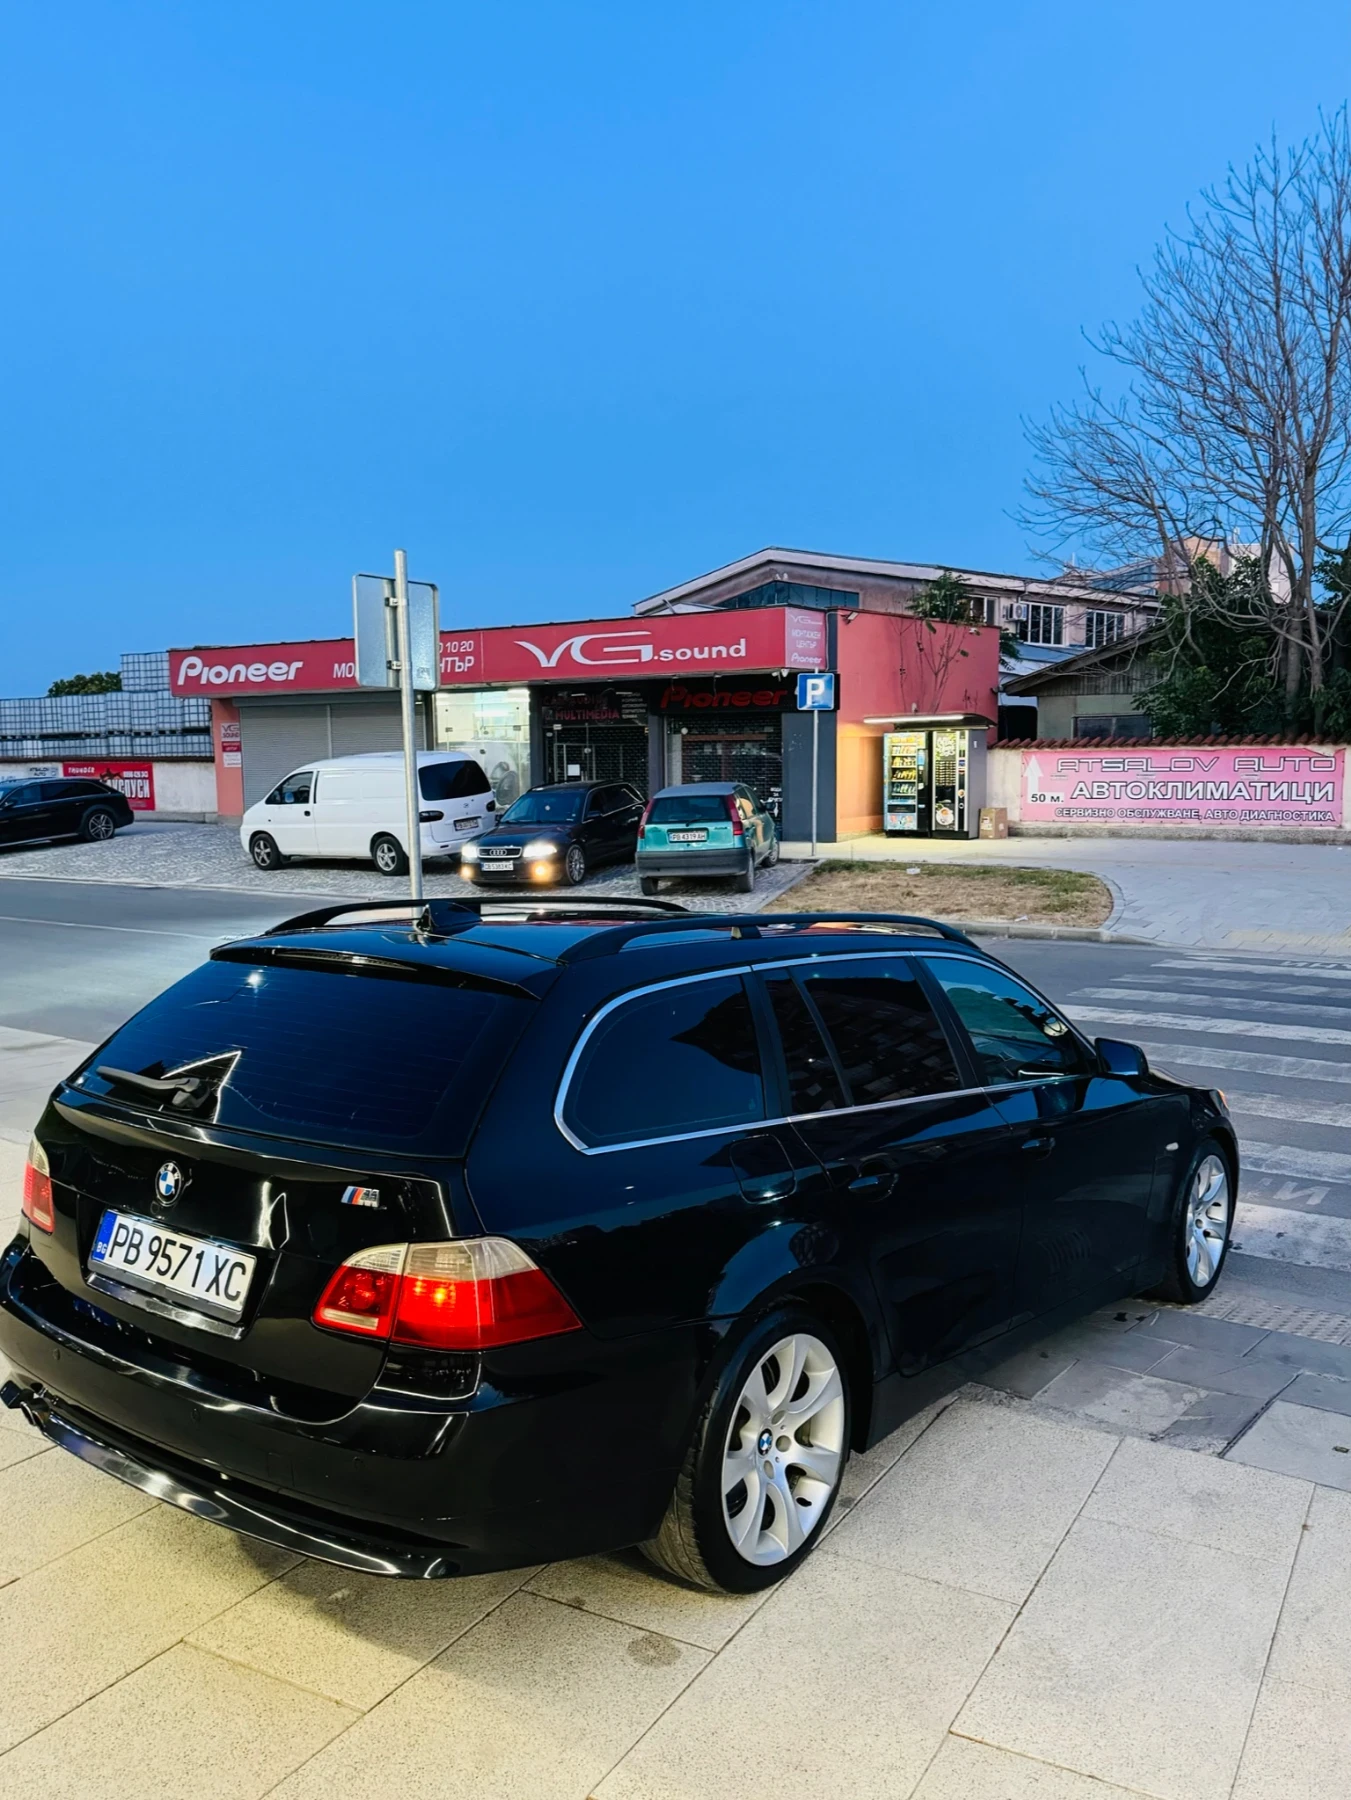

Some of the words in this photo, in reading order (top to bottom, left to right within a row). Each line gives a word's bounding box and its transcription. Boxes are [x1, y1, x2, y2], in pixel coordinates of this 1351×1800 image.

[445, 641, 459, 653] 10
[460, 640, 475, 652] 20
[440, 655, 475, 673] НТЪР
[791, 652, 823, 664] Pioneer
[177, 656, 304, 686] Pioneer
[333, 662, 354, 679] МО
[660, 686, 788, 709] Pioneer
[806, 679, 825, 706] P
[555, 708, 620, 721] MULTIMEDIA
[1057, 757, 1220, 773] ATSALOV
[1234, 756, 1336, 773] AUTO
[1031, 793, 1046, 803] 50
[1070, 781, 1335, 805] АВТОКЛИМАТИЦИ
[1055, 807, 1116, 818] СЕРВИЗНО
[1117, 808, 1202, 820] ОБСЛУЖВАНЕ,
[1204, 809, 1238, 820] АВТО
[1239, 810, 1336, 822] ДИАГНОСТИКА
[96, 1241, 108, 1255] BG
[109, 1222, 144, 1265] PB
[147, 1235, 205, 1289] 9571
[205, 1254, 247, 1302] XC
